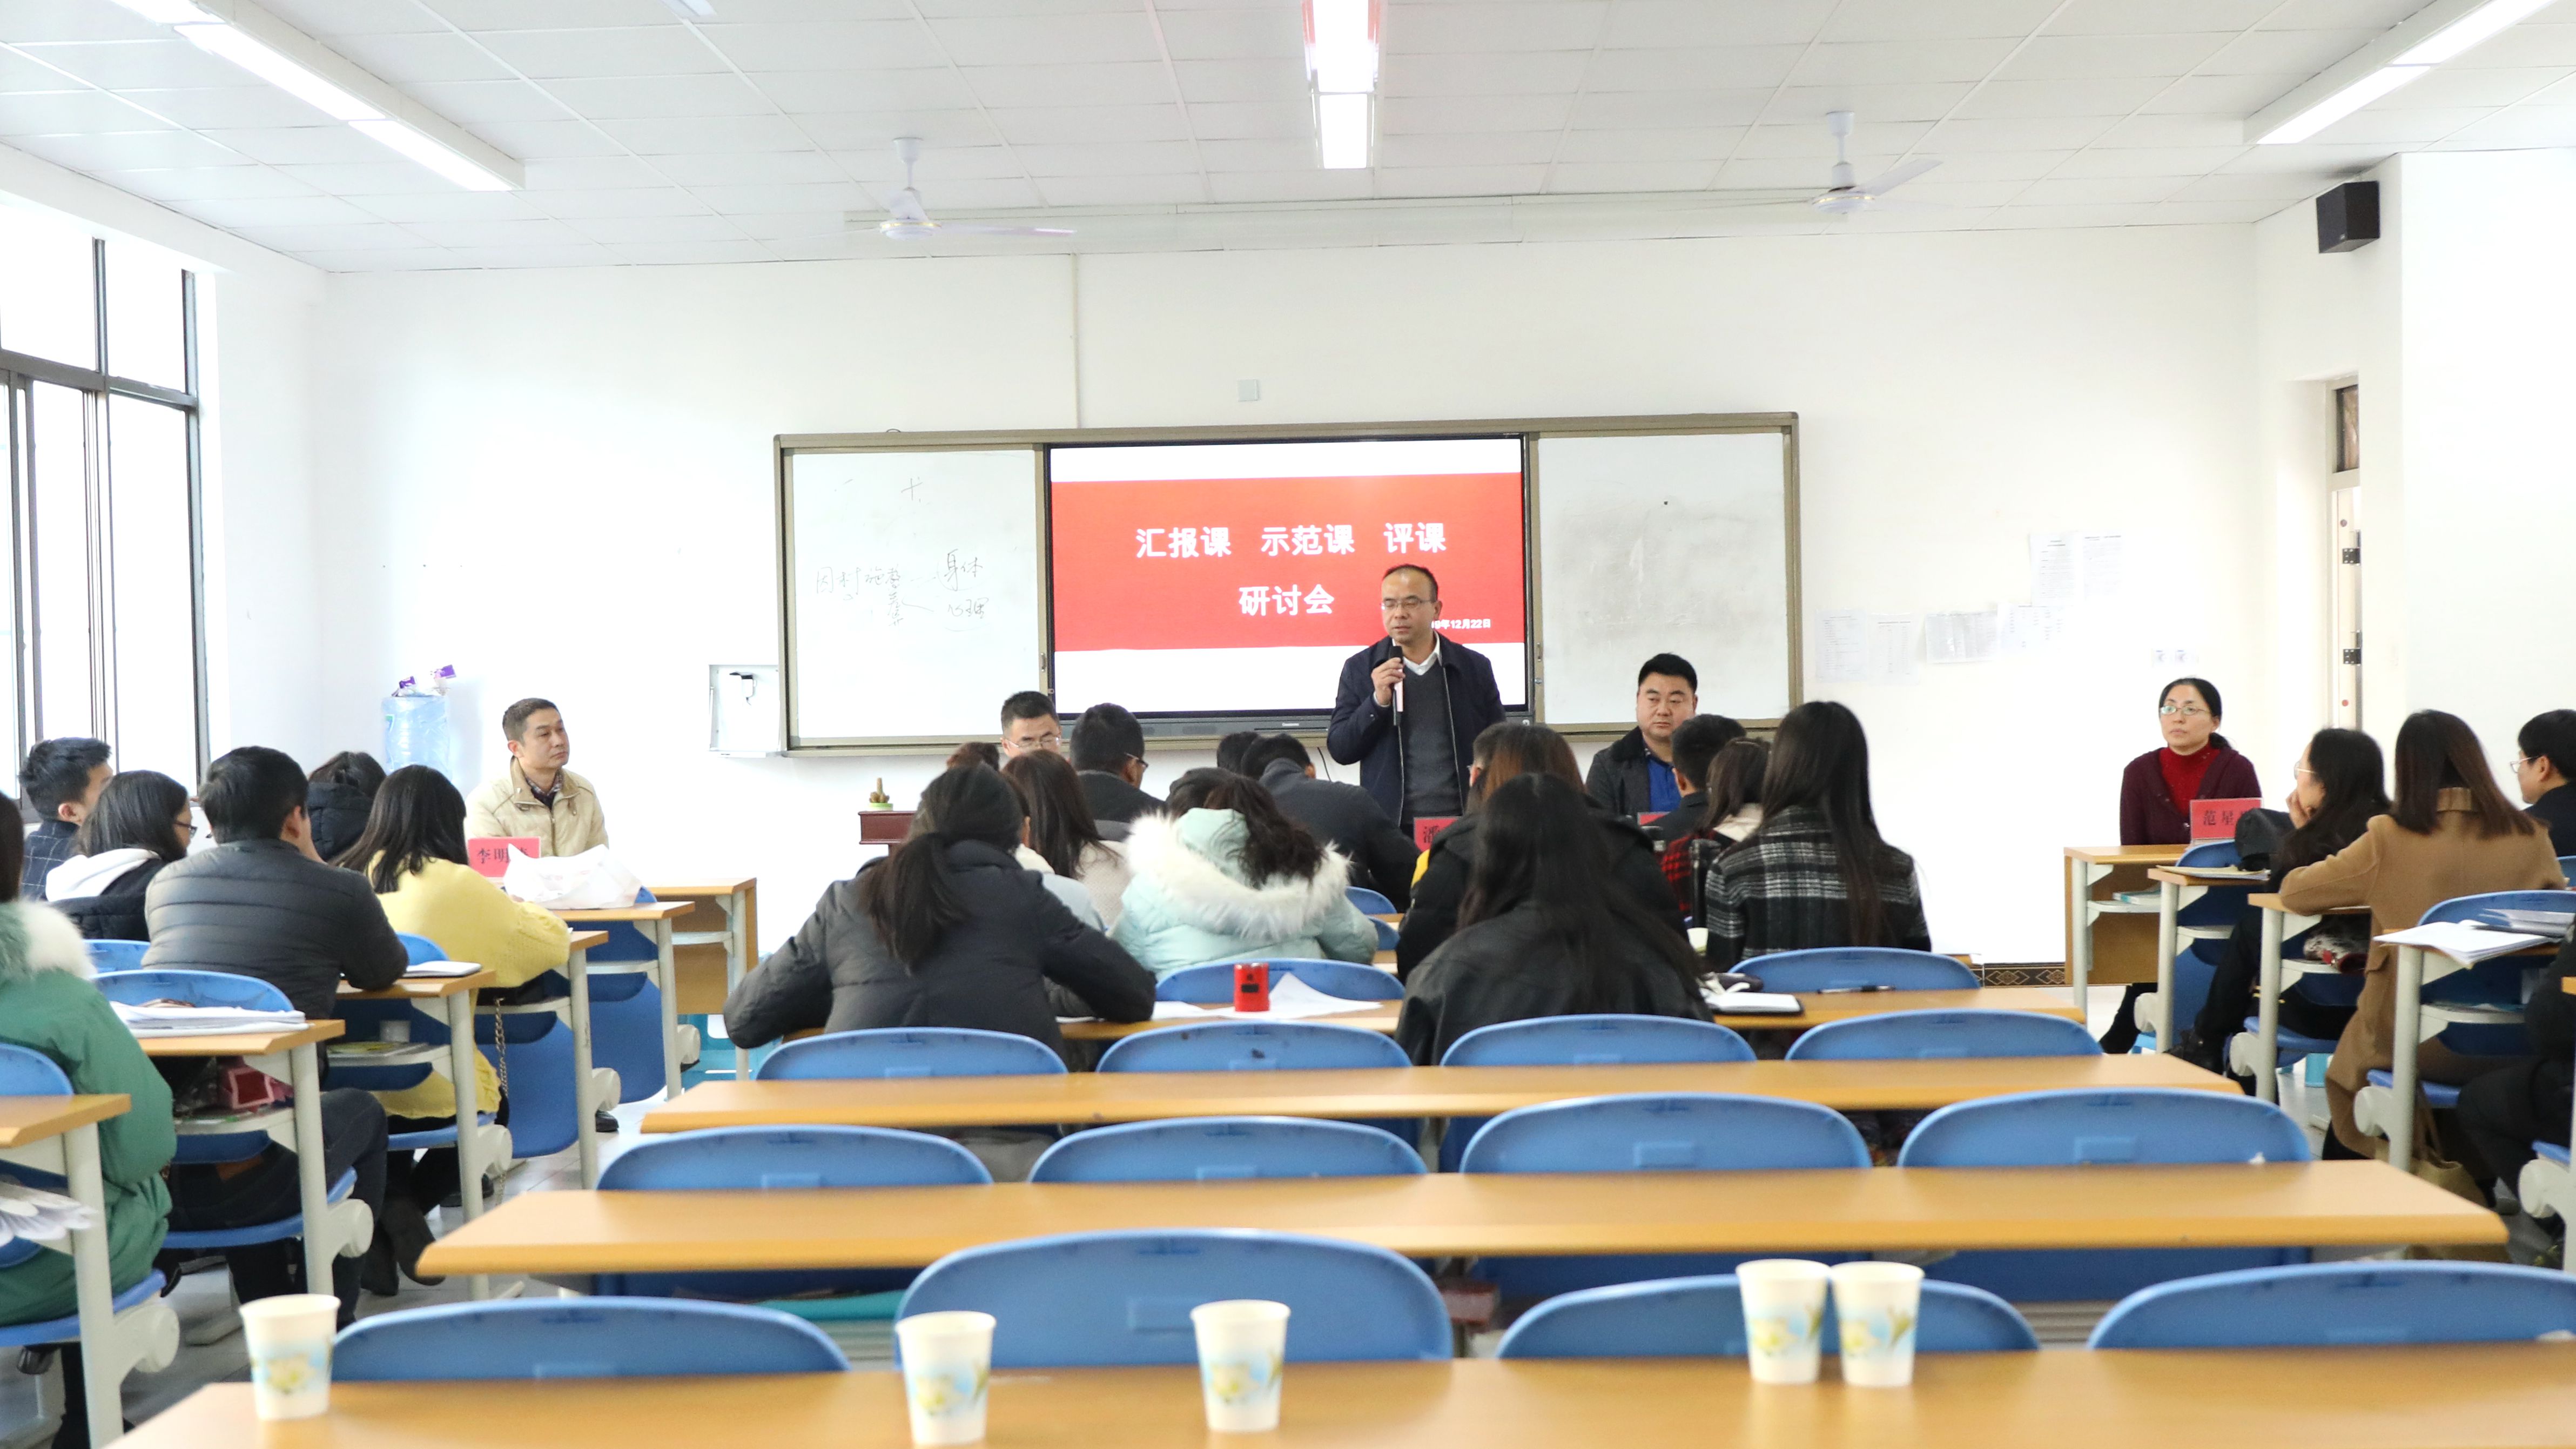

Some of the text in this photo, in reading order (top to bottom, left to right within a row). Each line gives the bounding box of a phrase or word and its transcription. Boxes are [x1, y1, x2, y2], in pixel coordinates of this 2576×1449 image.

[1136, 522, 1447, 558] 汇报课 示范课 评课
[1239, 583, 1335, 616] 研讨会
[477, 847, 528, 864] 李明
